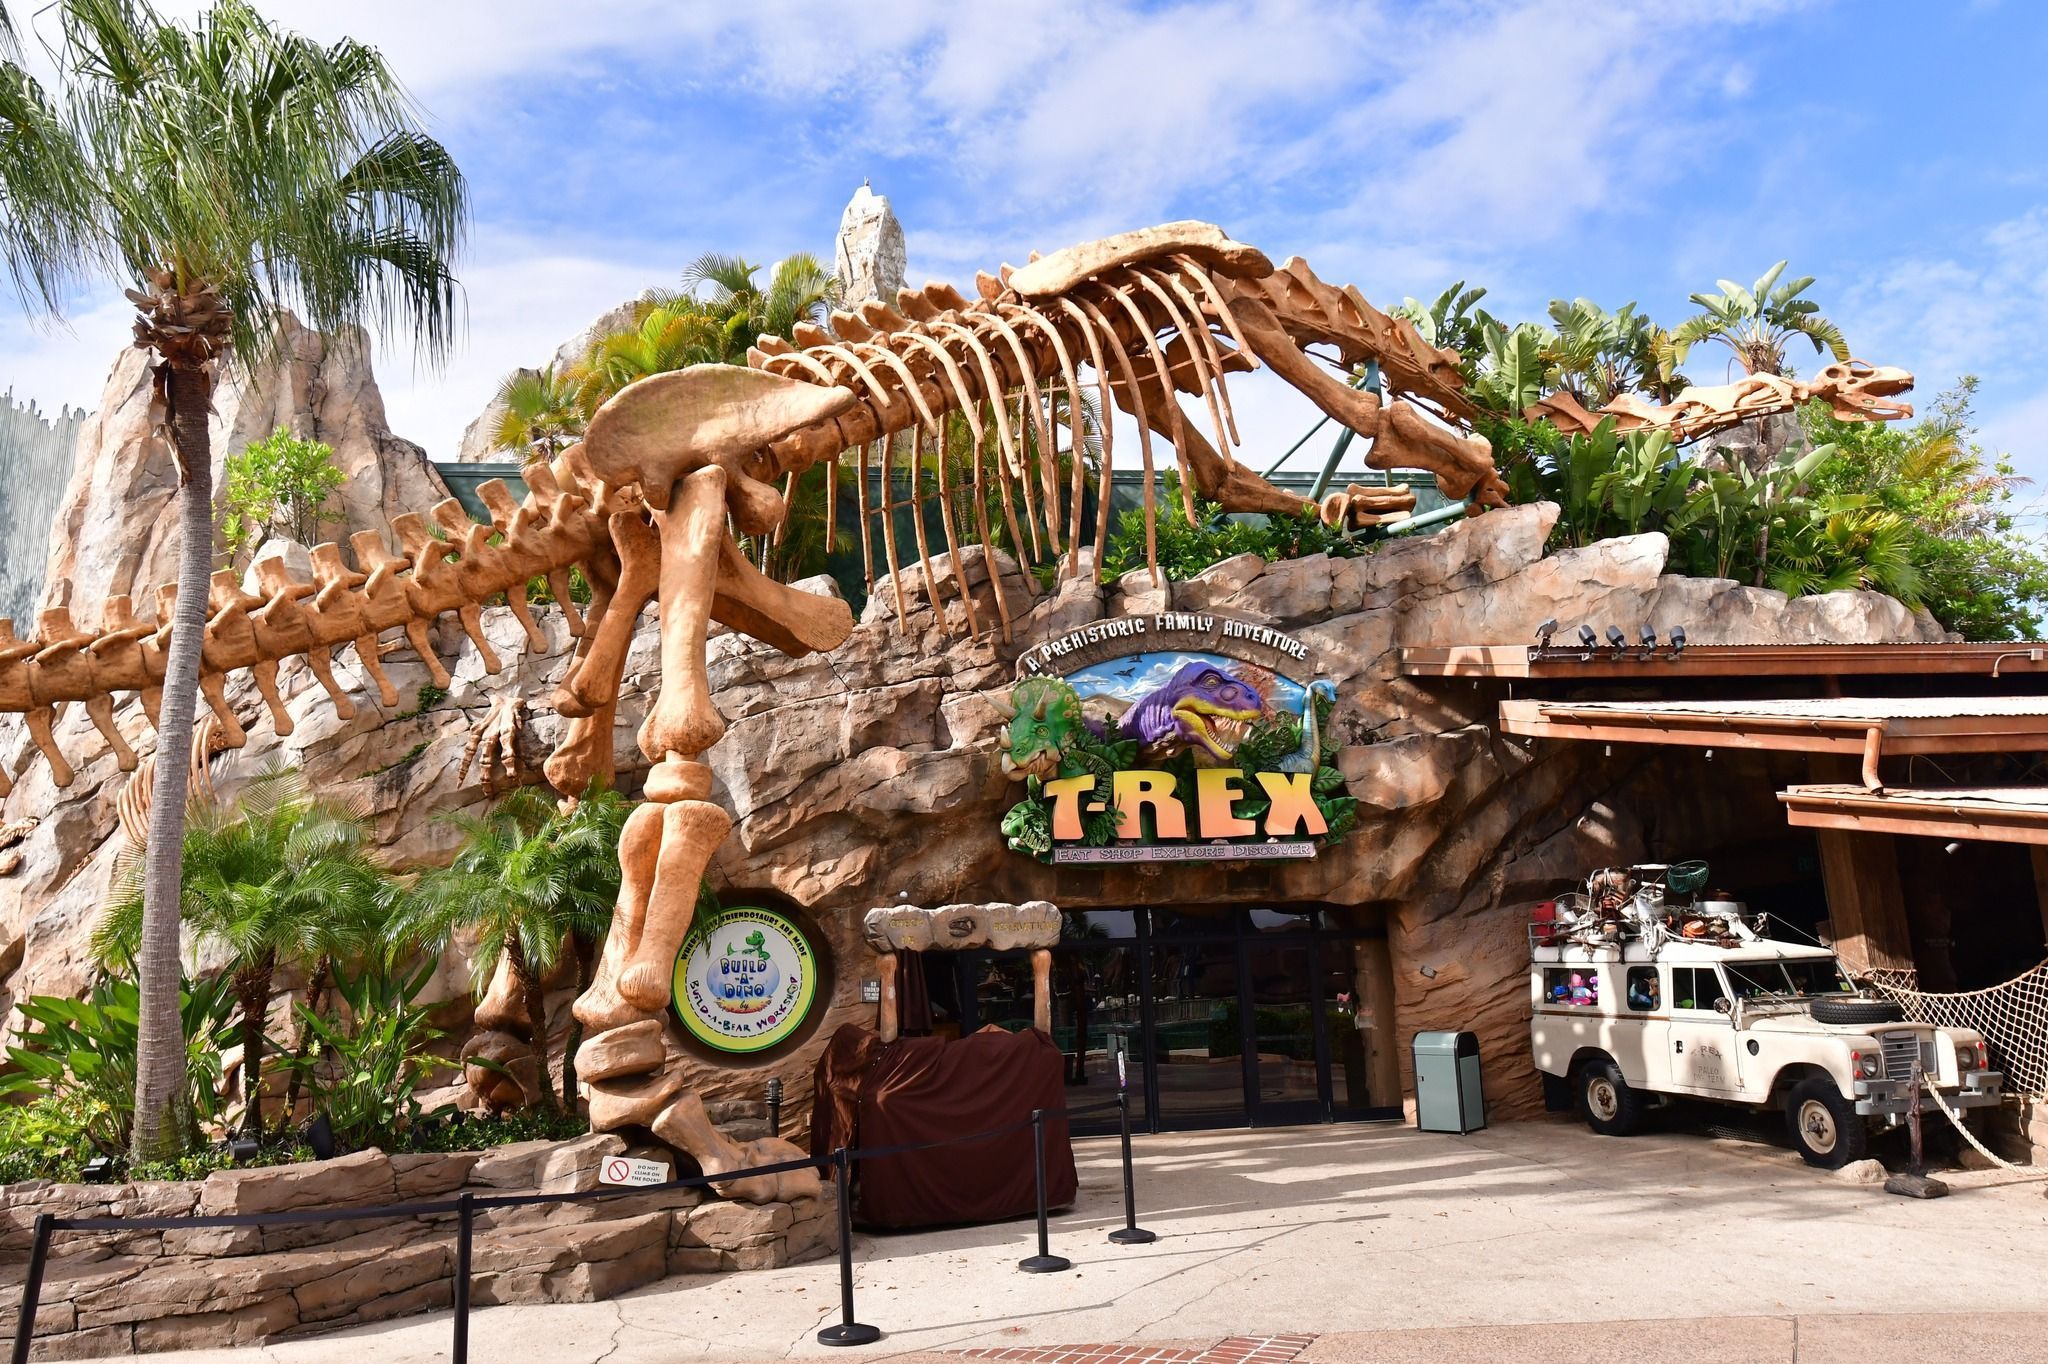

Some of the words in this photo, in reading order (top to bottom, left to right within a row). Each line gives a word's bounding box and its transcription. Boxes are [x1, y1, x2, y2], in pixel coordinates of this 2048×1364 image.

[1028, 656, 1041, 671] A
[1040, 617, 1146, 662] PREHISTORIC
[1155, 614, 1215, 632] FAMILY
[1222, 619, 1309, 661] ADVENTURE
[1045, 768, 1329, 840] T-REX
[1057, 848, 1092, 861] EAT
[1100, 847, 1144, 860] SHOP
[1151, 846, 1225, 859] EXPLORE
[1233, 842, 1310, 857] DISCOVER
[779, 922, 794, 937] ARE
[791, 935, 808, 957] MADE
[720, 957, 768, 975] BUILD
[724, 983, 766, 999] DINO
[739, 1000, 749, 1010] by
